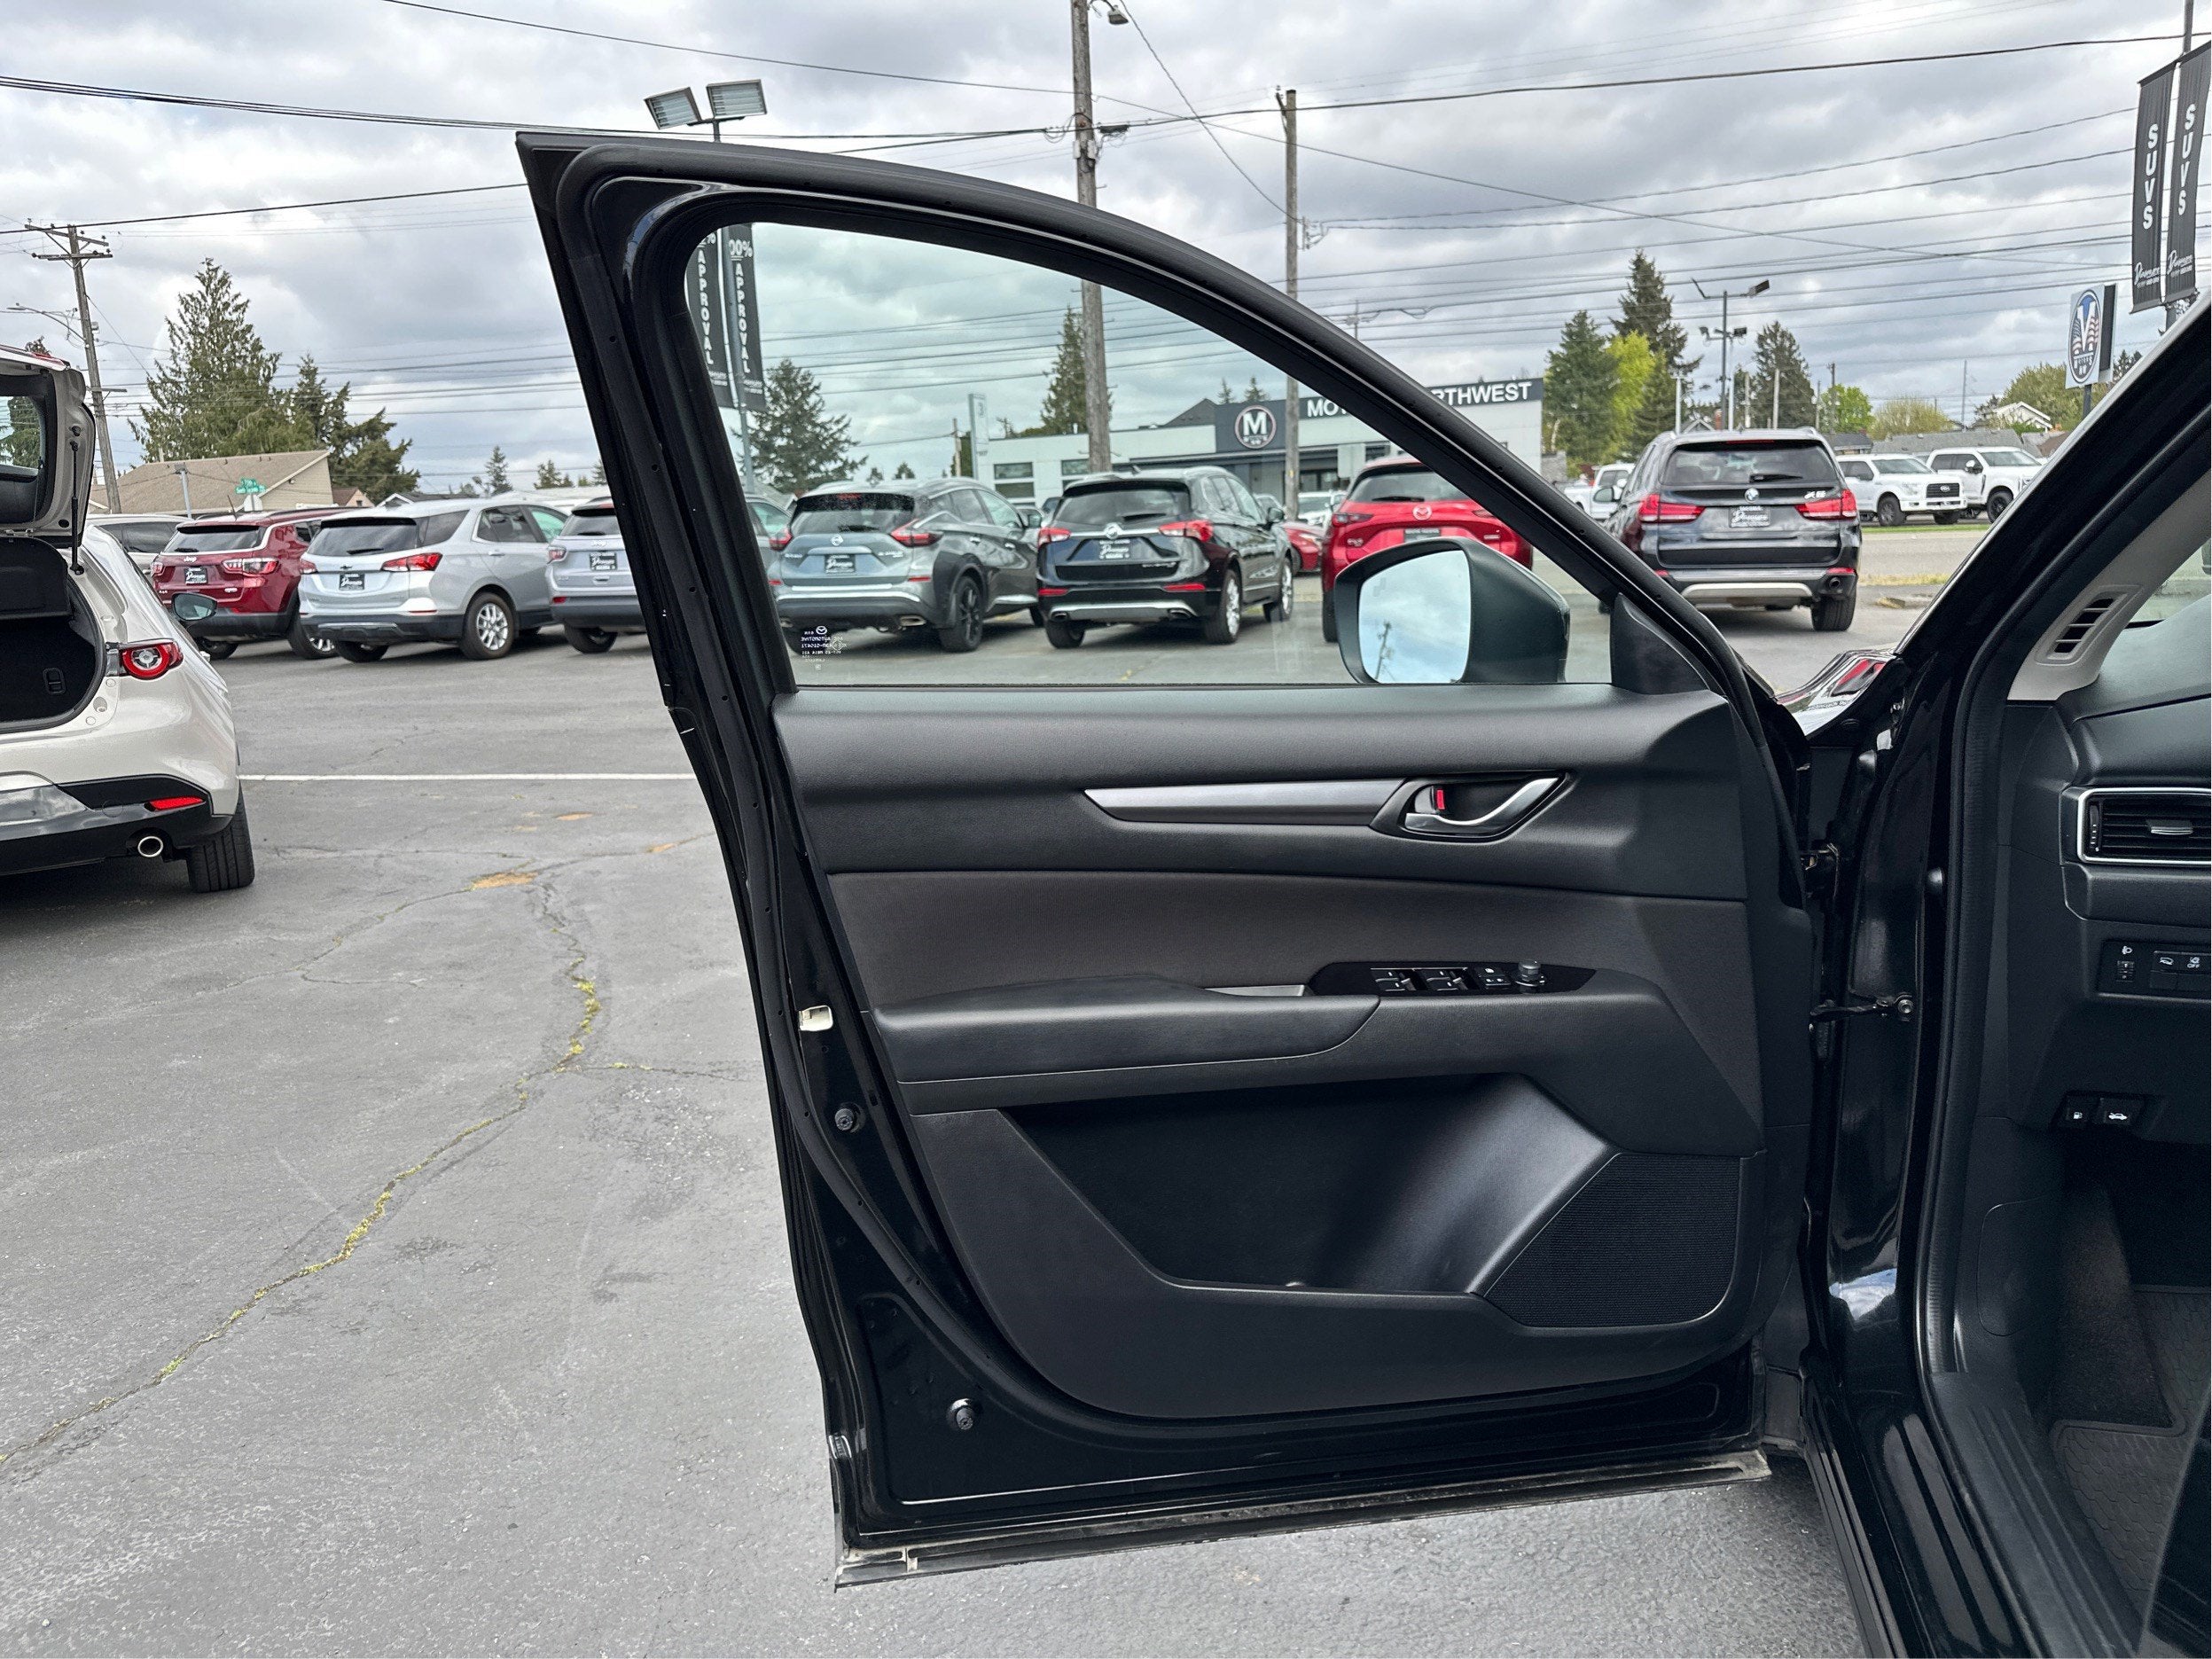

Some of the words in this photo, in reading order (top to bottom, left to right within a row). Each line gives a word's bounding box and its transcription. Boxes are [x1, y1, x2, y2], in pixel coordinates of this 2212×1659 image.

[2143, 123, 2158, 230] SUVS
[2178, 104, 2196, 215] SUVS
[697, 249, 715, 364] APPROVAL
[735, 262, 751, 373] APPROVAL
[1243, 411, 1267, 435] M
[1308, 398, 1346, 417] MO
